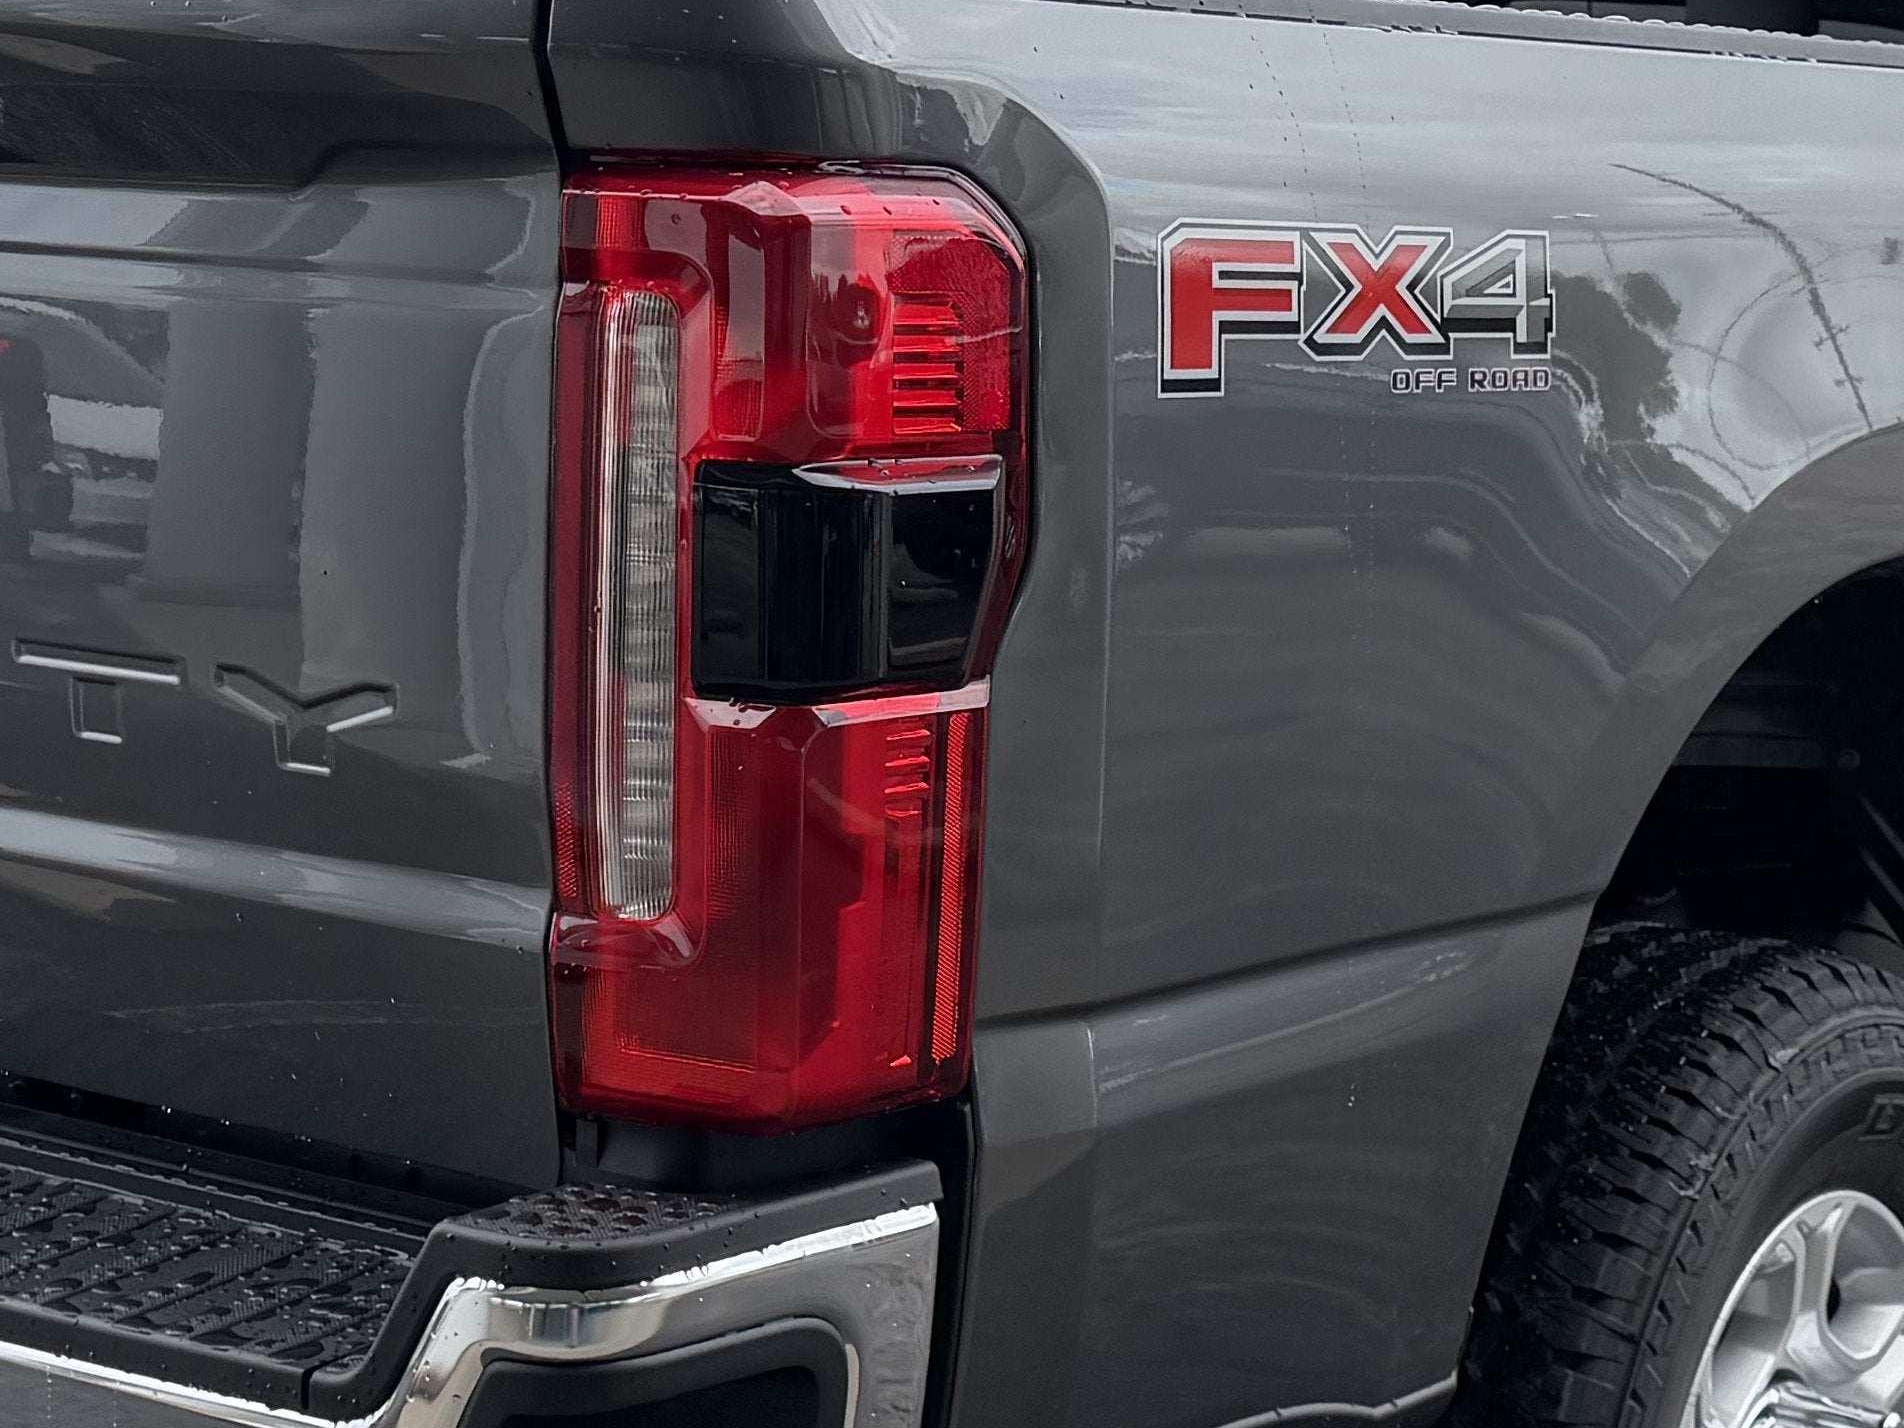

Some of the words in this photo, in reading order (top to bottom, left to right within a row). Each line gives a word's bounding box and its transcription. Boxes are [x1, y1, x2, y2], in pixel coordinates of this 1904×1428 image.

[1158, 217, 1555, 397] FX4
[1390, 368, 1457, 393] OFF
[1468, 368, 1550, 392] ROAD
